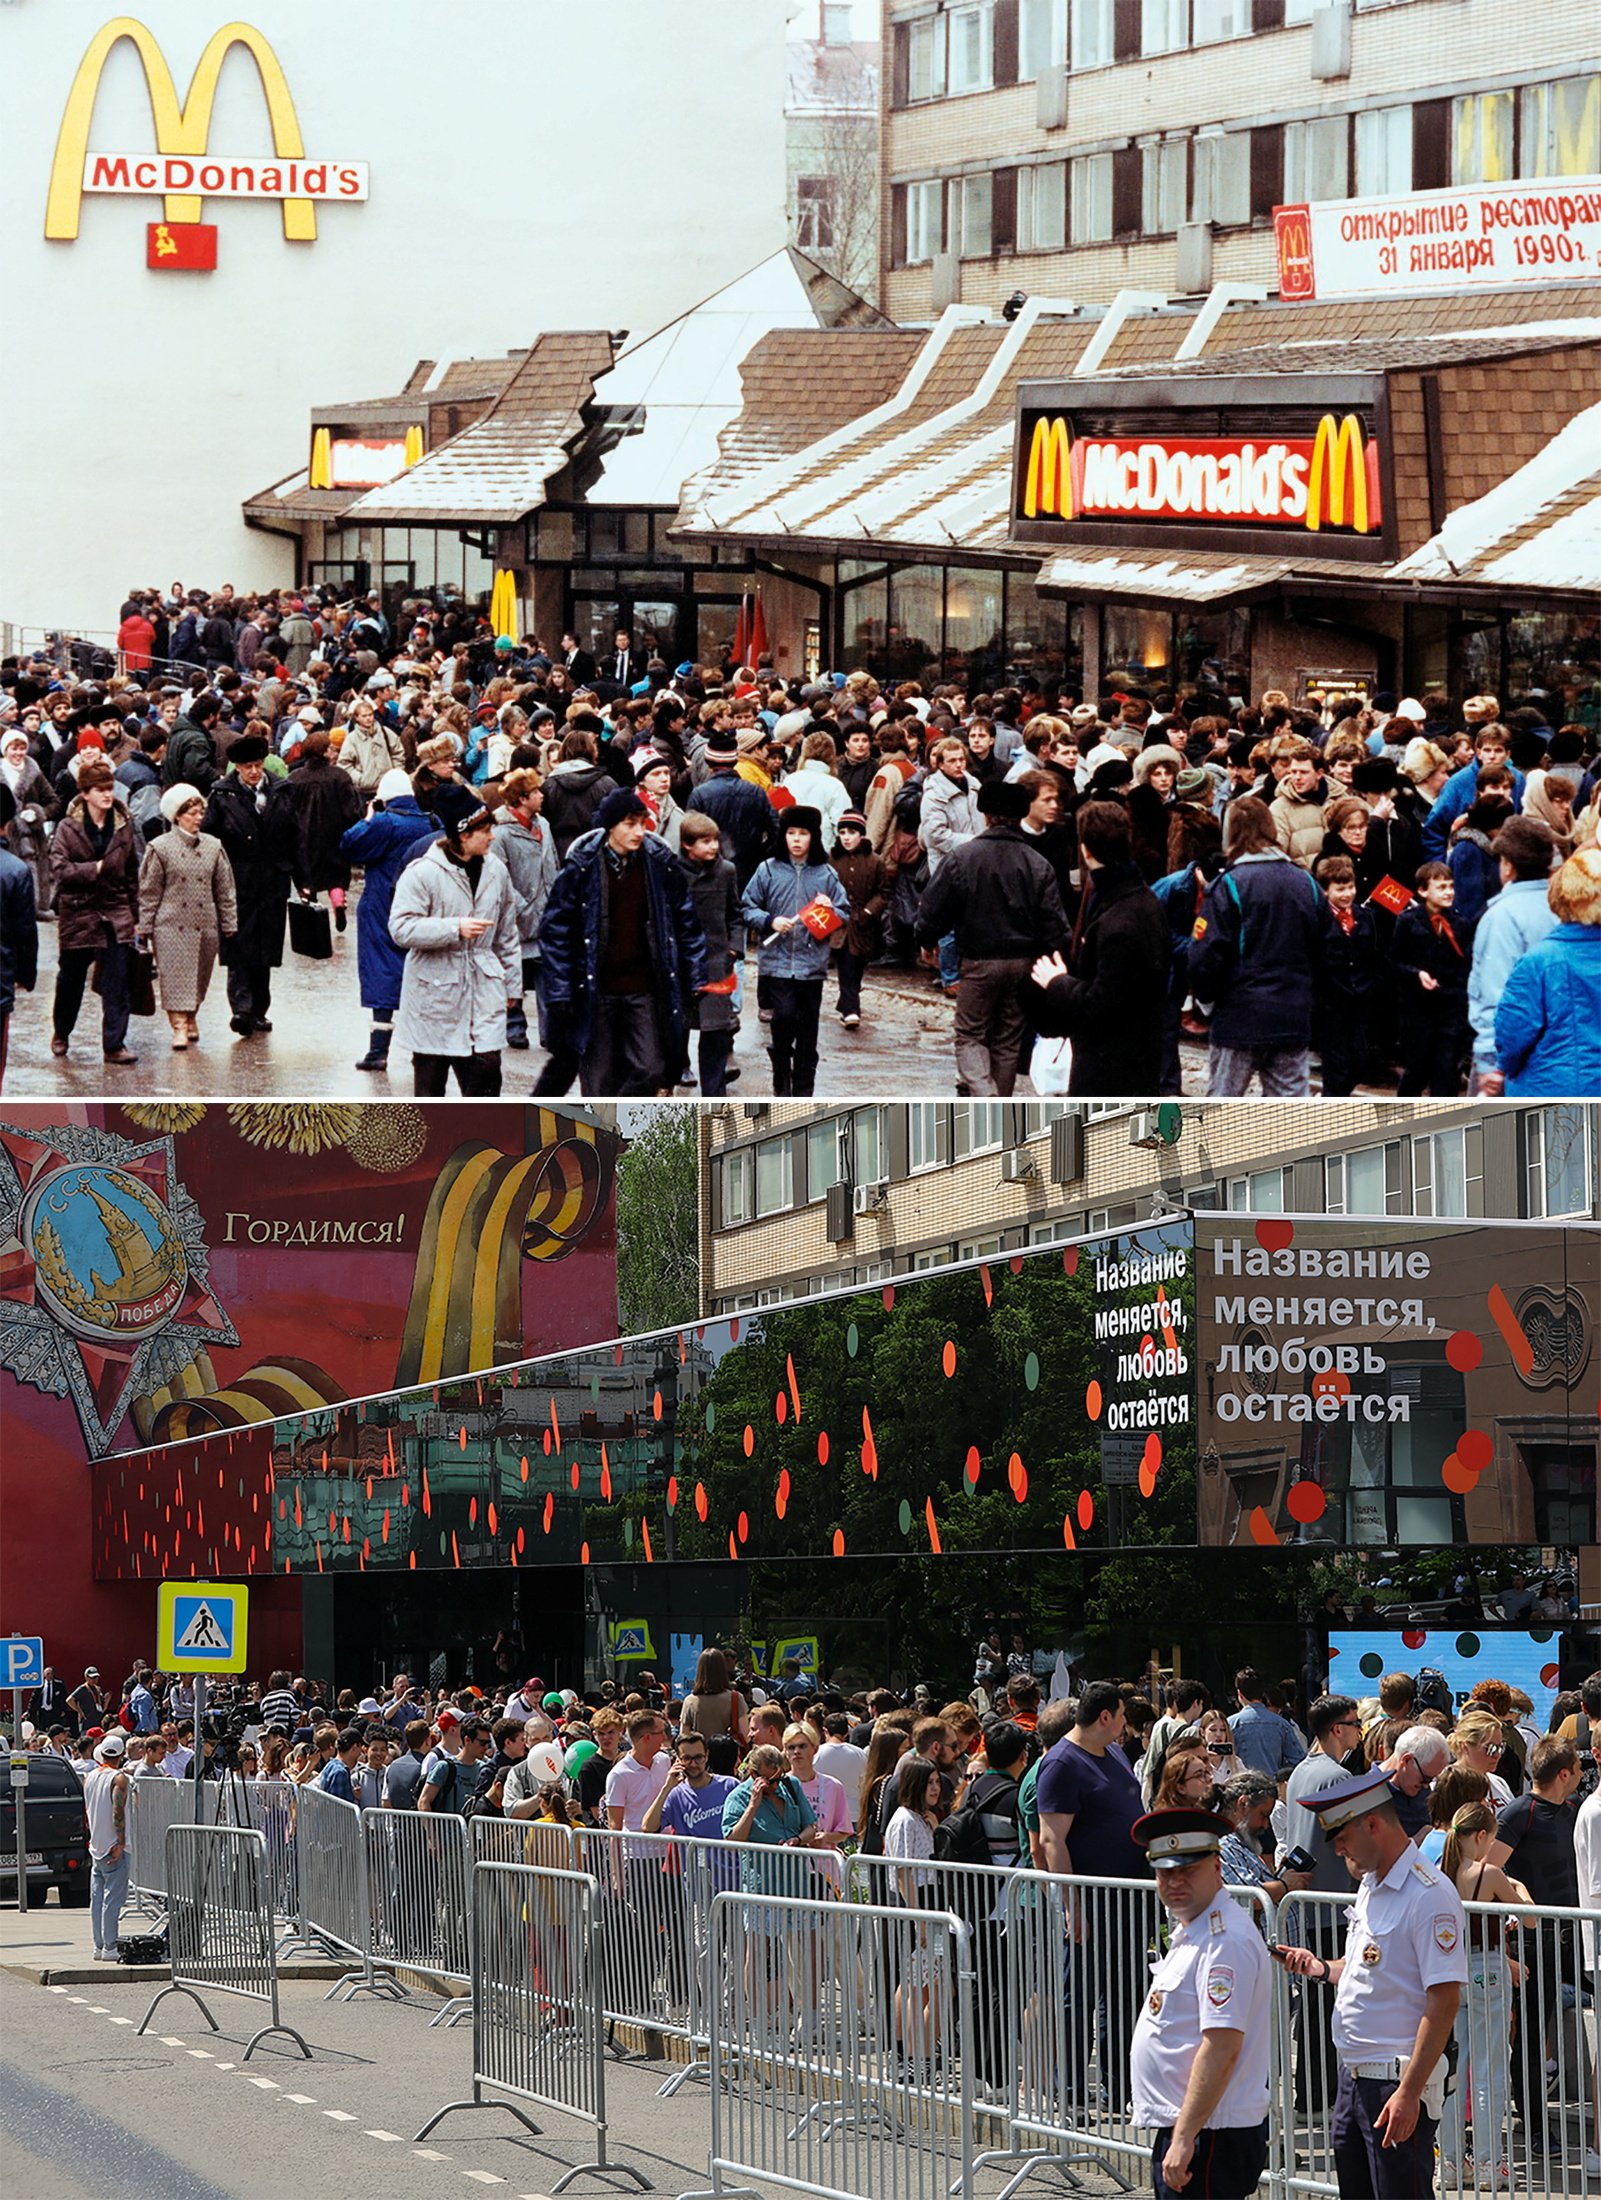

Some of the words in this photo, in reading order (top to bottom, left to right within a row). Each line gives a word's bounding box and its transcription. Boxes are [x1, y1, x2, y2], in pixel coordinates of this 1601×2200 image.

[92, 157, 359, 195] McDonald's
[1379, 246, 1398, 275] 31
[1410, 237, 1495, 274] января
[1083, 444, 1310, 517] McDonald's
[48, 1170, 103, 1213] СССР
[1096, 1249, 1186, 1293] Название
[1214, 1239, 1431, 1279] Название
[120, 1283, 180, 1322] ПОБЕДА
[1095, 1298, 1188, 1340] меняется,
[1214, 1296, 1437, 1334] меняется,
[1116, 1342, 1188, 1383] любовь
[1216, 1336, 1386, 1374] любовь
[1107, 1388, 1189, 1431] остаётся
[1216, 1385, 1411, 1422] остаётся
[8, 1644, 34, 1682] P
